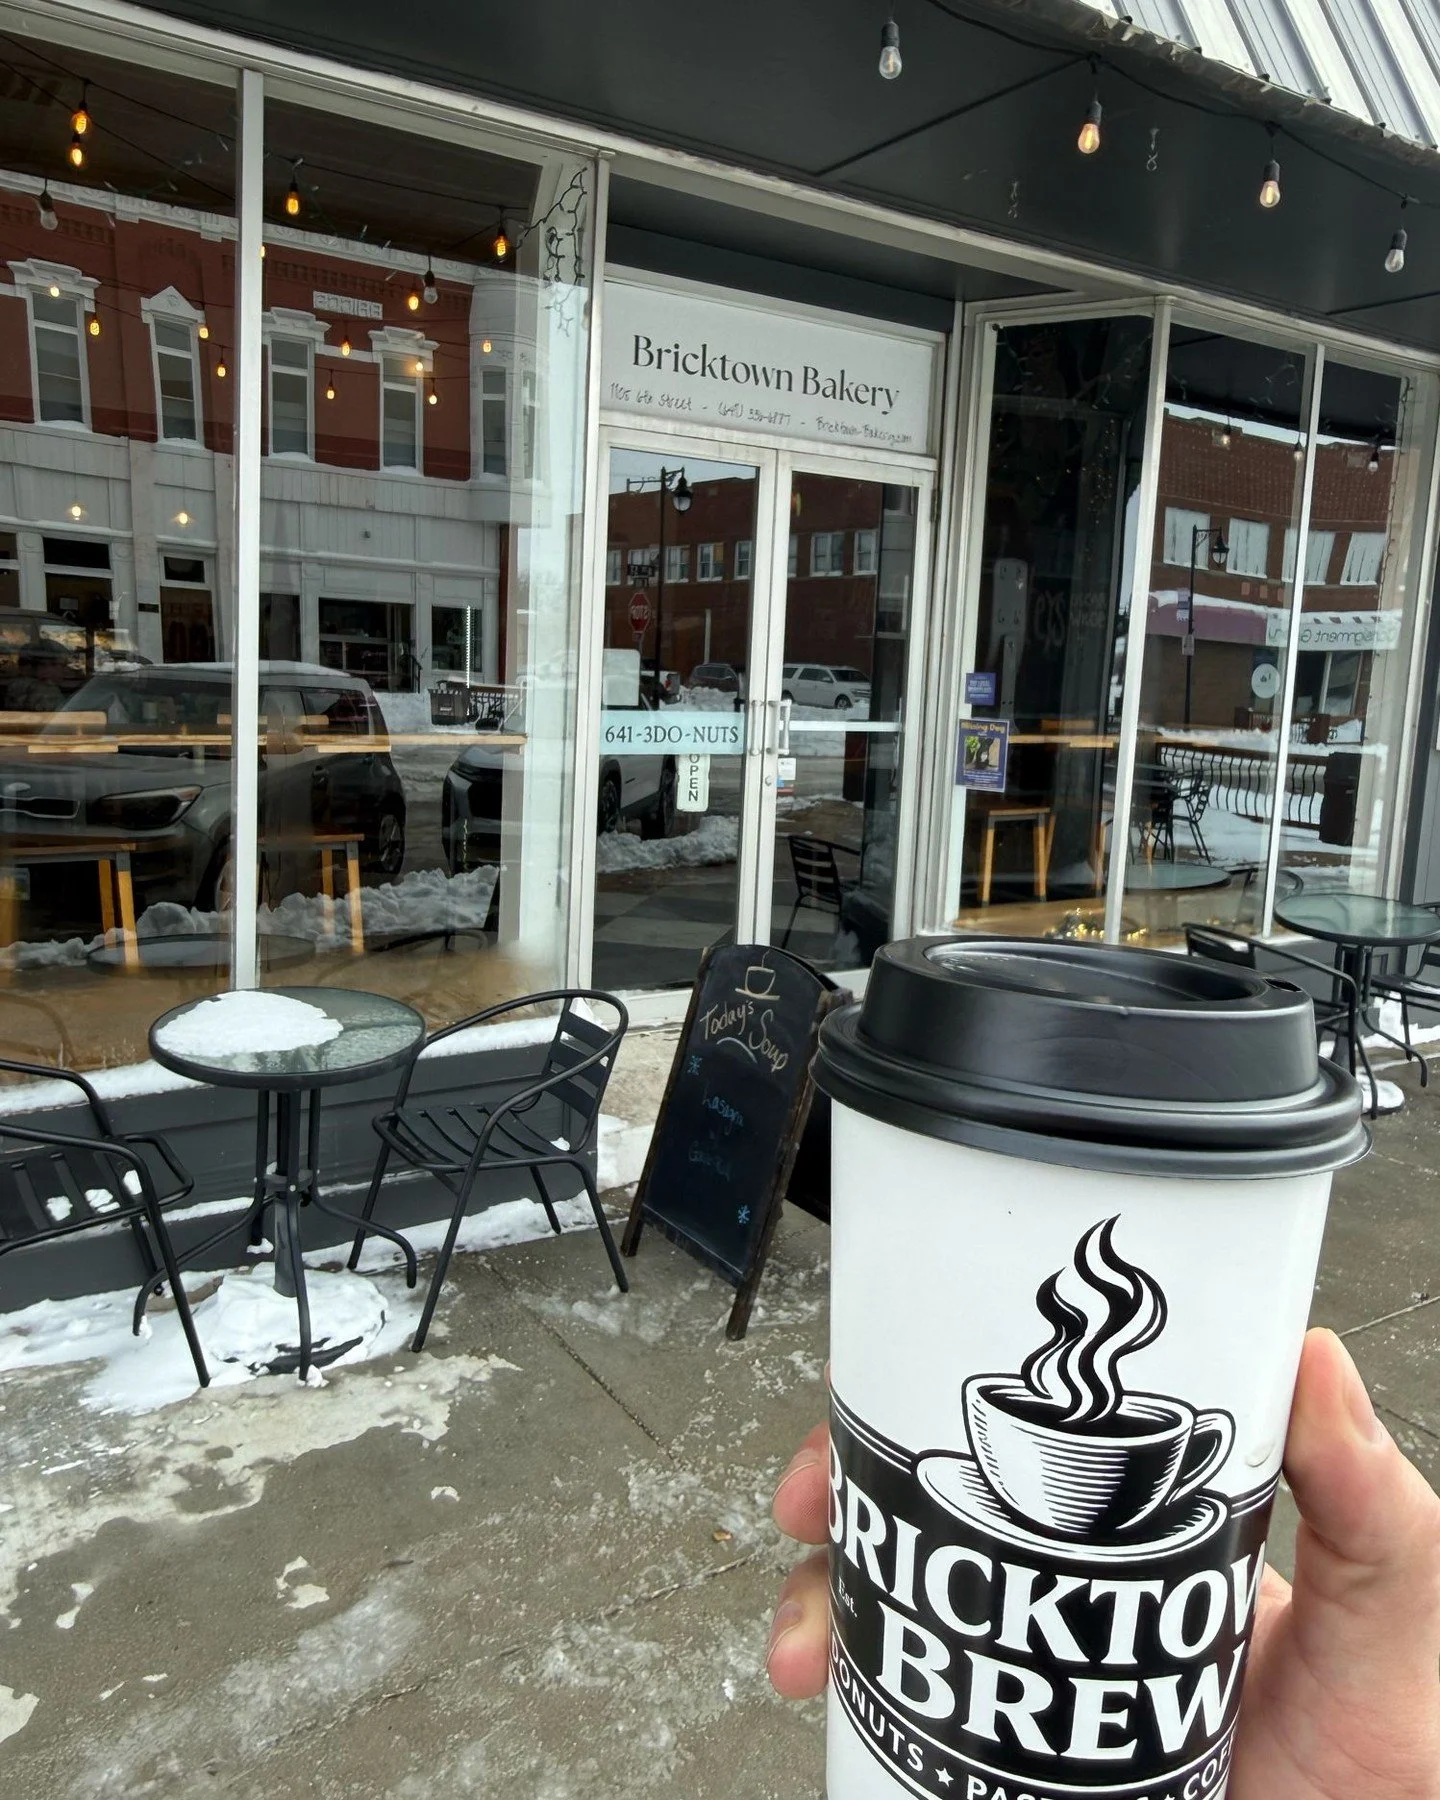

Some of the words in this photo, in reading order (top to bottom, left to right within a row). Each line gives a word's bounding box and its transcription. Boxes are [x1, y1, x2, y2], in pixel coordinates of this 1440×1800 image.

[632, 334, 793, 393] Bricktown
[801, 365, 900, 416] Bakery
[605, 725, 739, 744] 641-3DO-NUTS
[688, 753, 699, 802] OPEN
[700, 1001, 754, 1041] Today's
[749, 1009, 789, 1072] Soup
[829, 1436, 1266, 1665] BRICKTOW
[832, 1631, 924, 1772] DONUTS
[876, 1601, 1247, 1760] BREW
